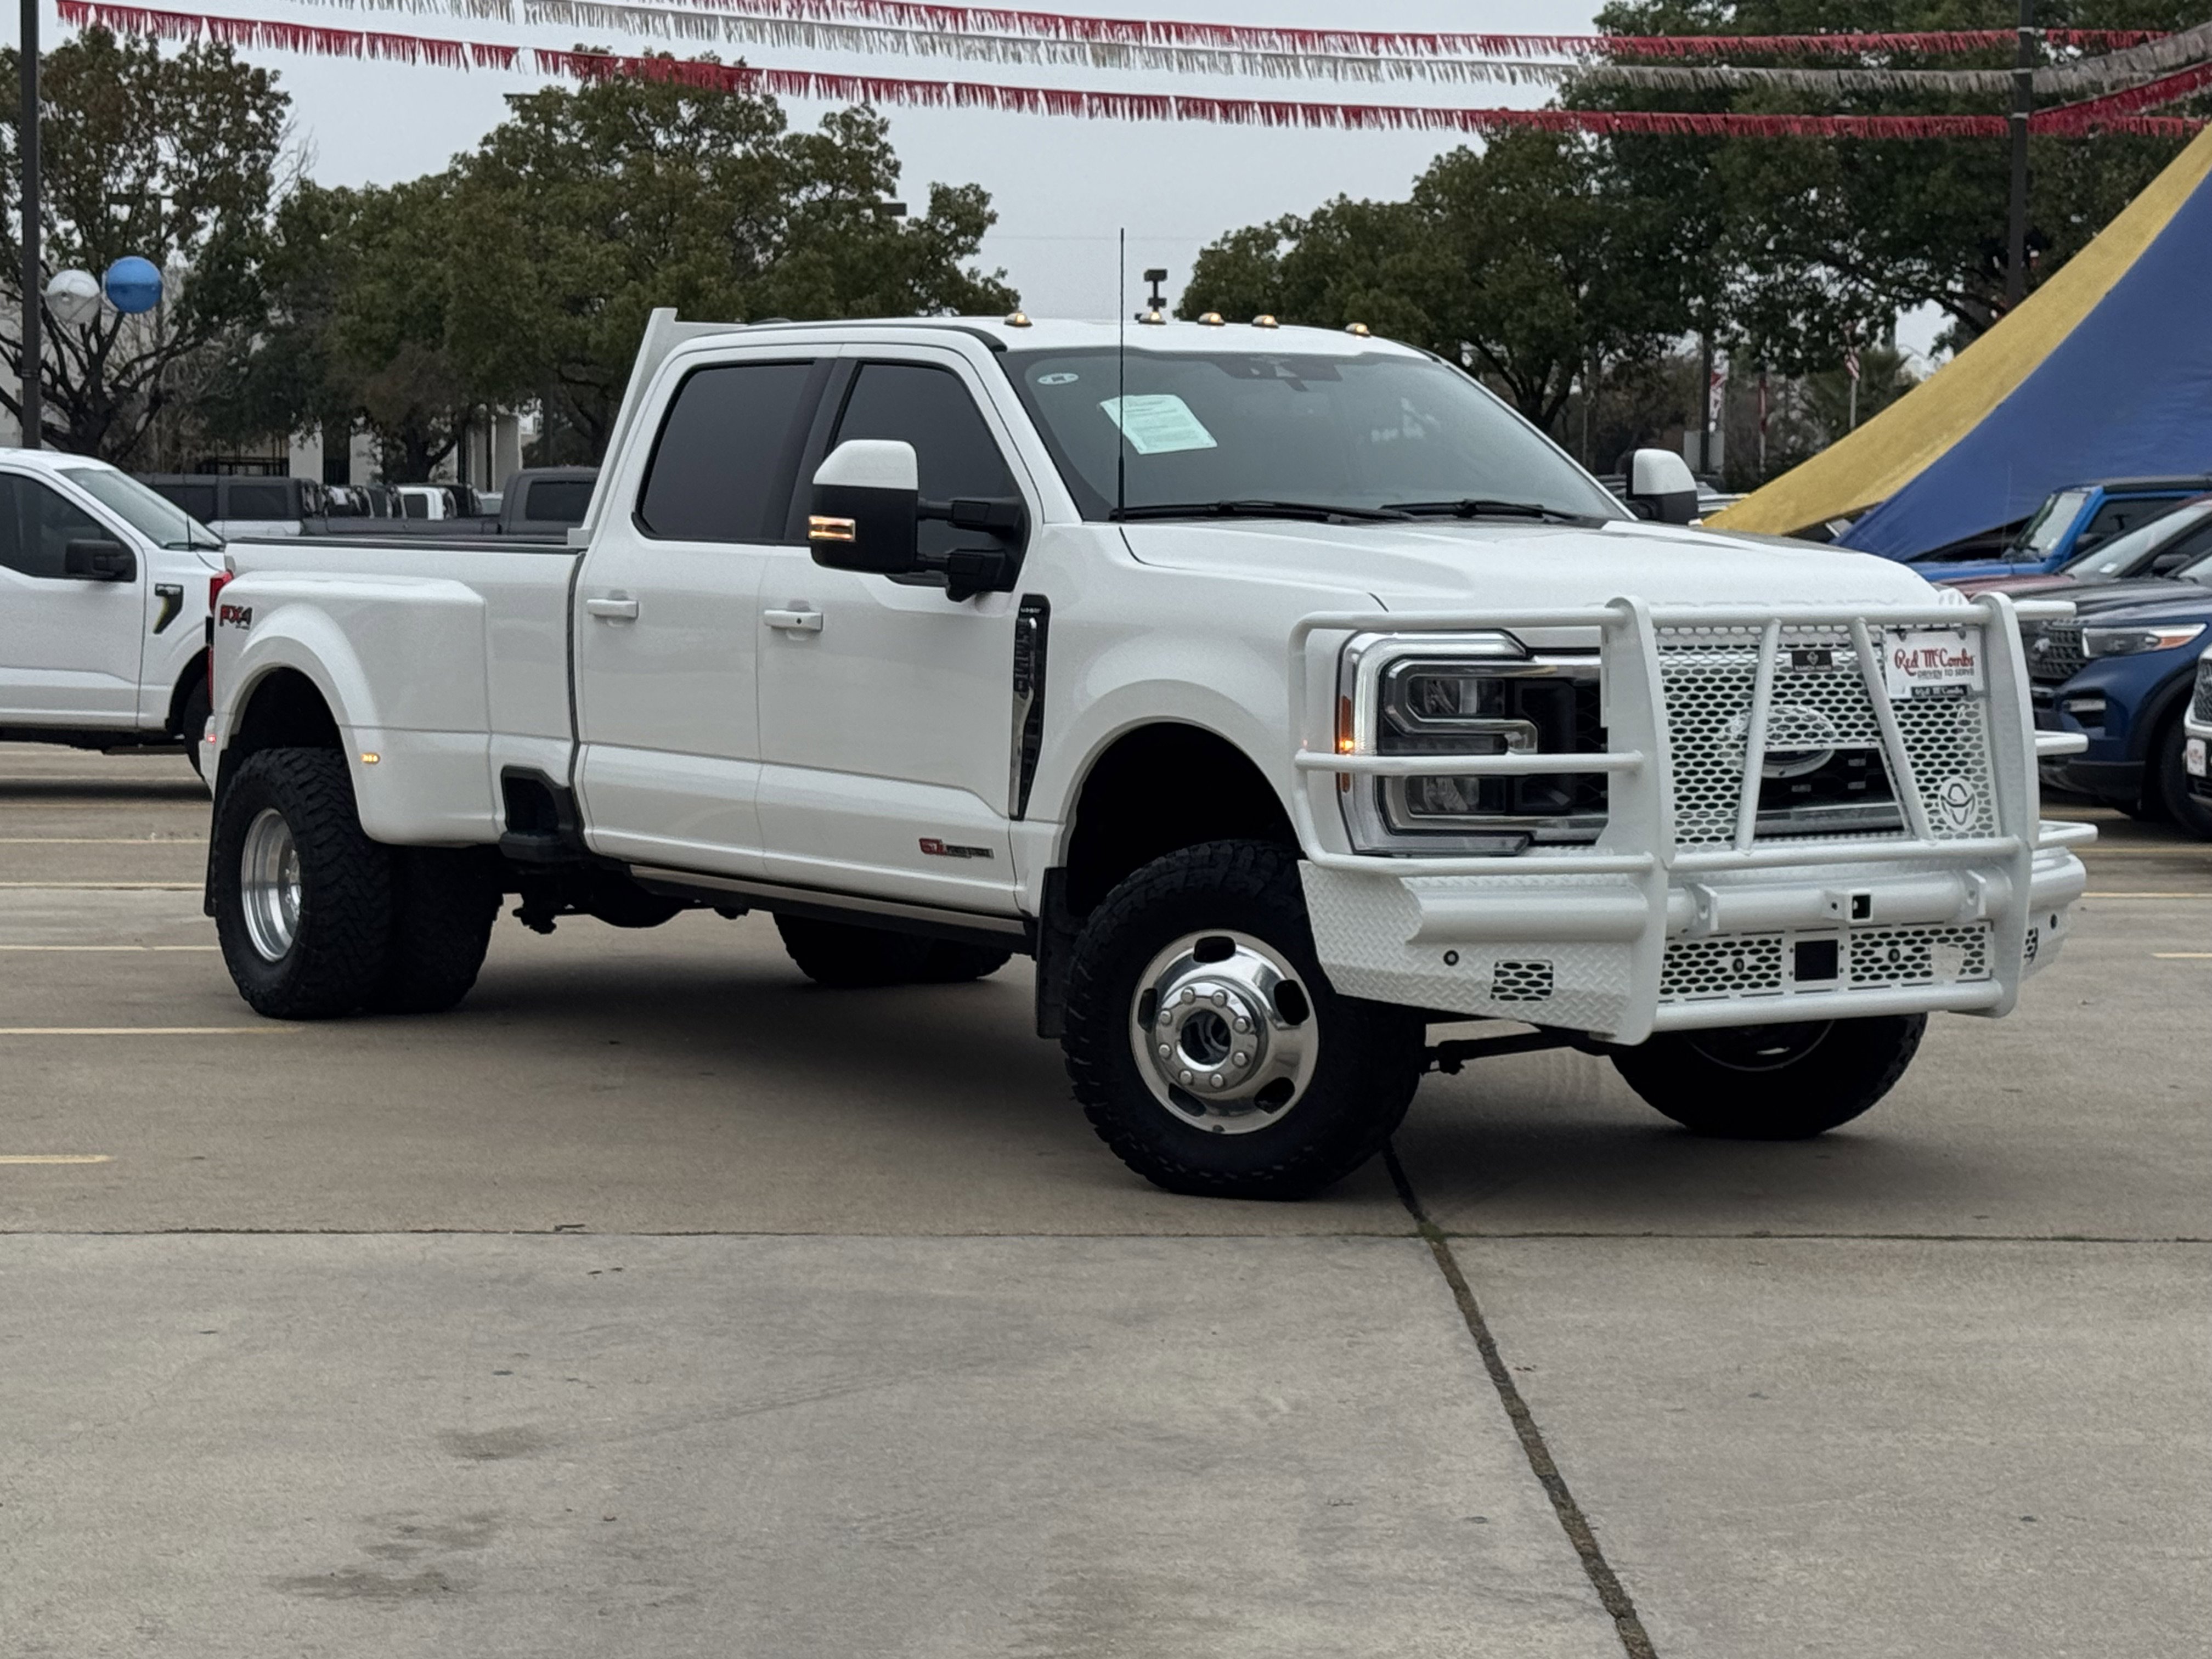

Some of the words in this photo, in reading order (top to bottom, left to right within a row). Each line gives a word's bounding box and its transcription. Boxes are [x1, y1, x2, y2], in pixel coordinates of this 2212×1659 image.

[219, 605, 252, 627] FX4
[1894, 648, 1919, 676] Red
[1920, 647, 1975, 668] McCombs
